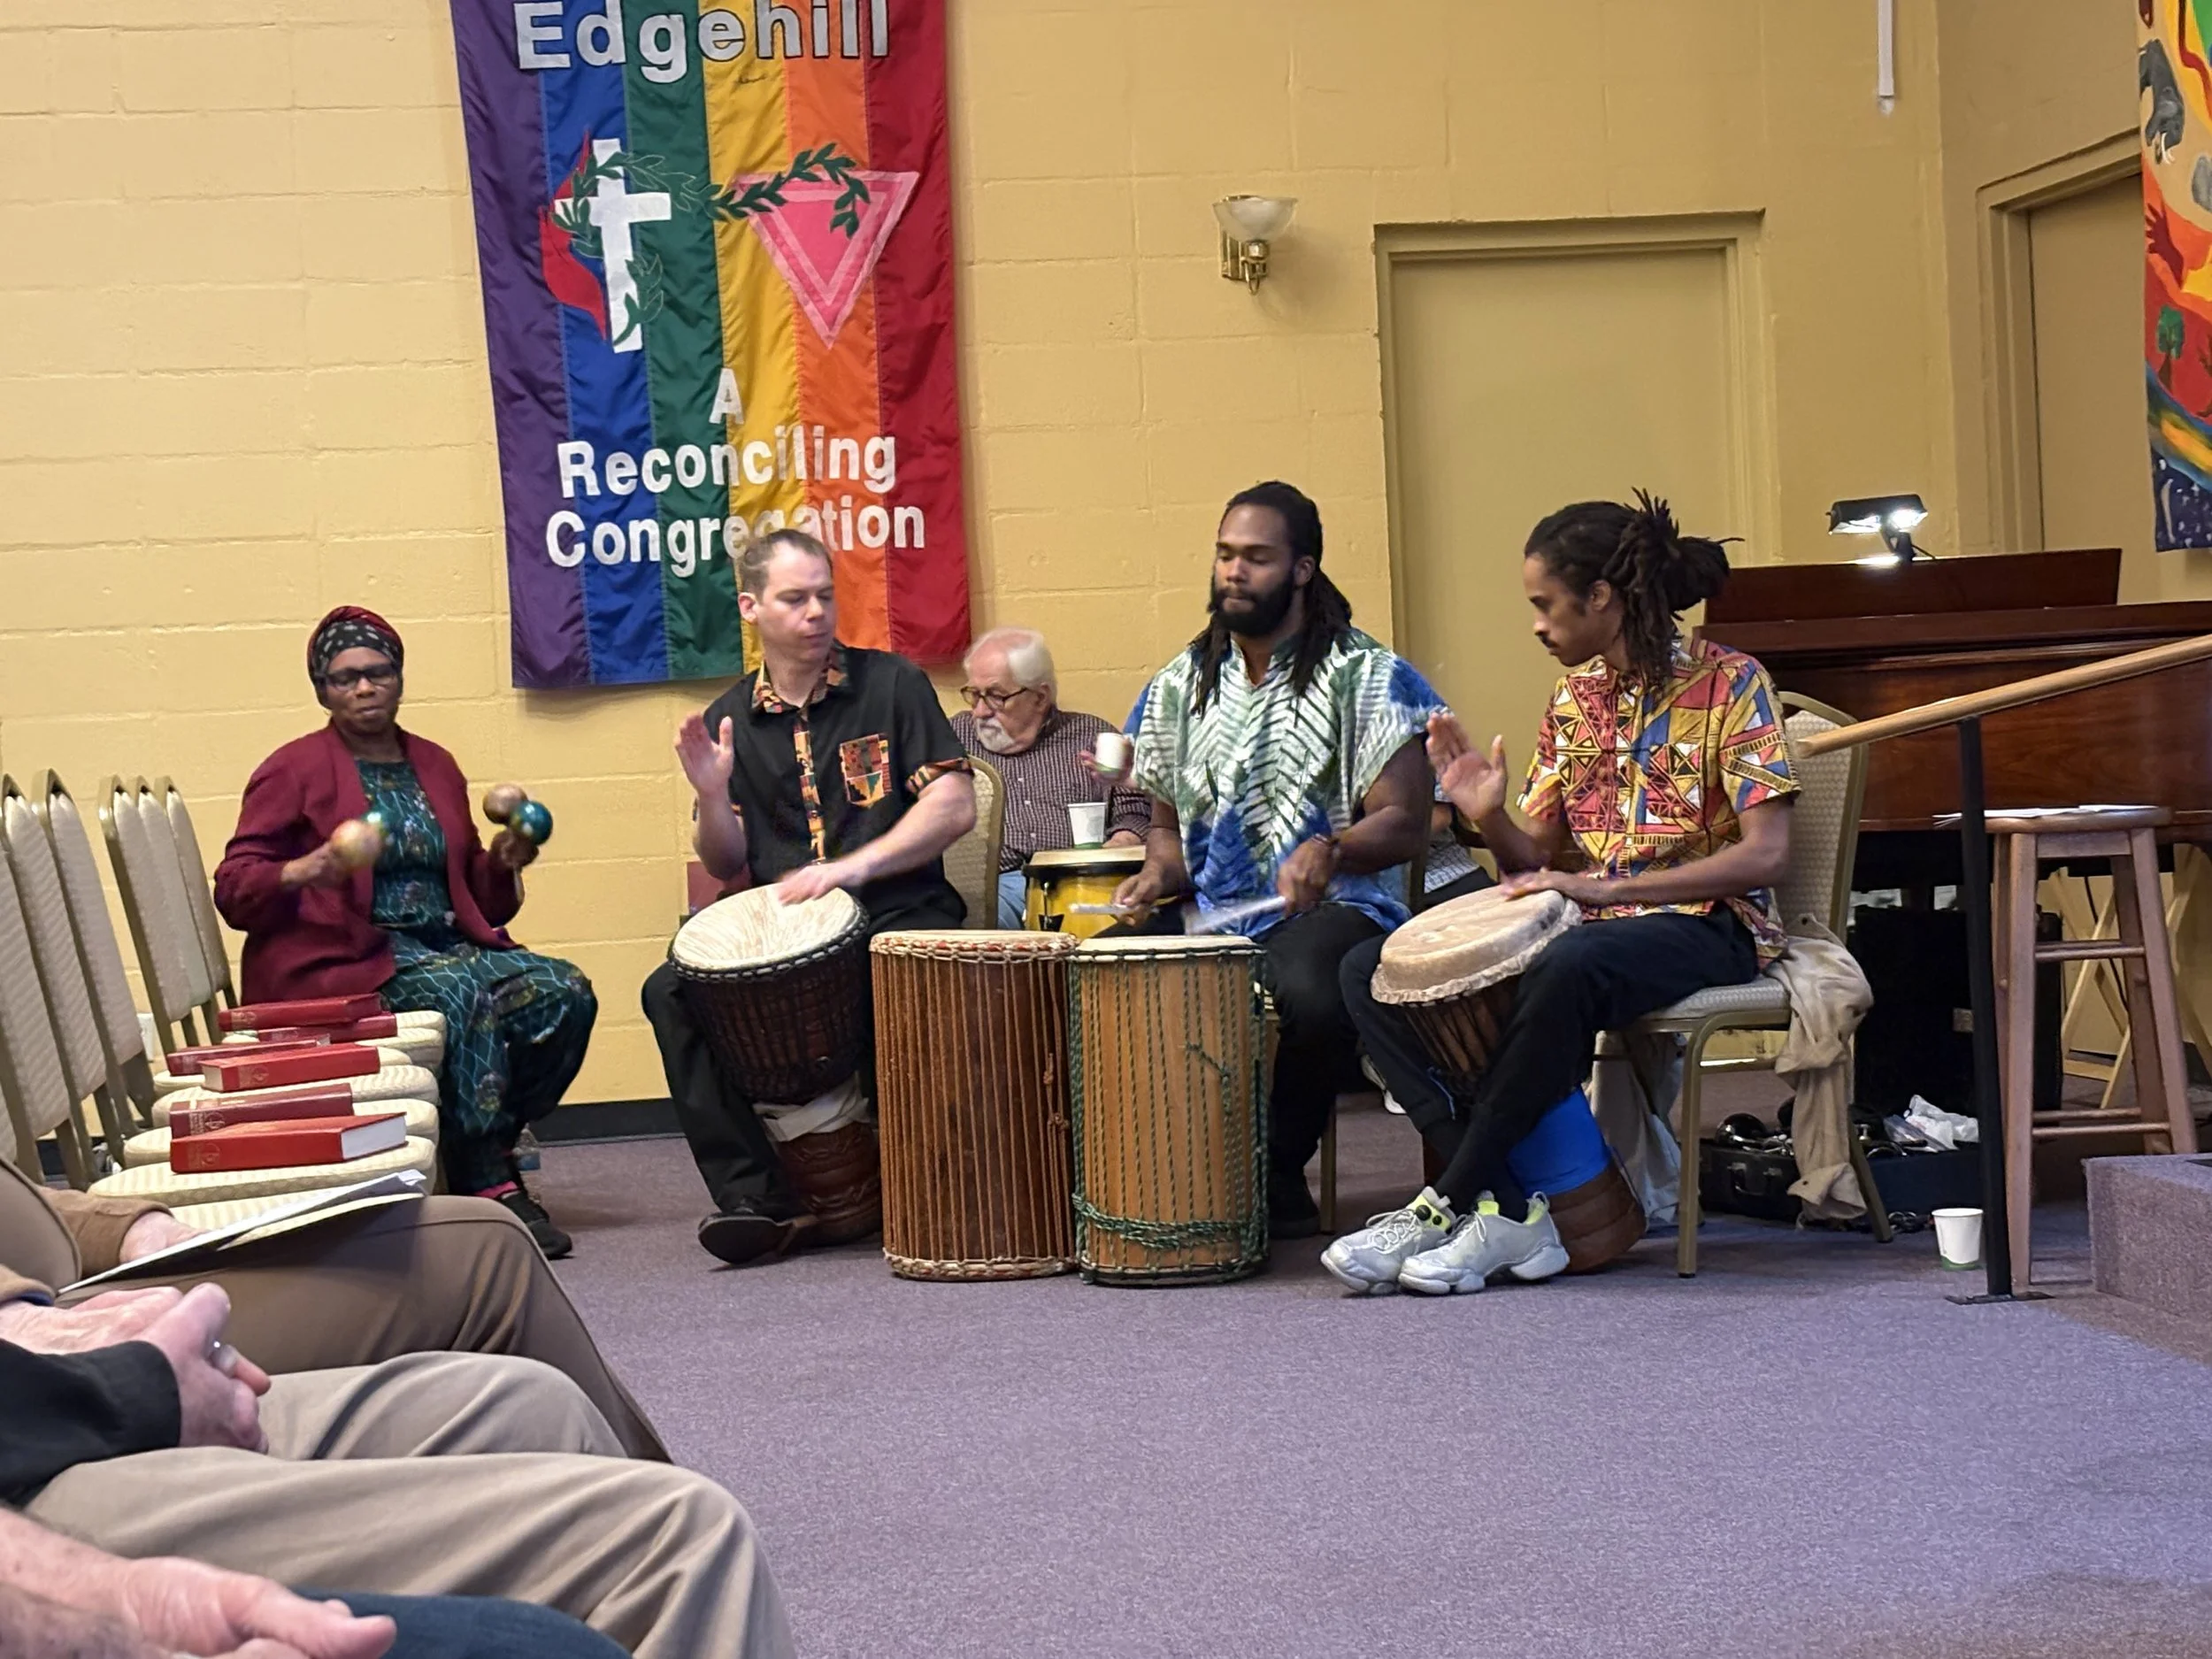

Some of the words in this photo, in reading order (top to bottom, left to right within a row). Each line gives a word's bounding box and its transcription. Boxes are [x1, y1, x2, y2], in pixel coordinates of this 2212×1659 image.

[514, 0, 888, 83] Edgehill
[709, 367, 744, 425] A
[557, 425, 896, 498] Reconciling
